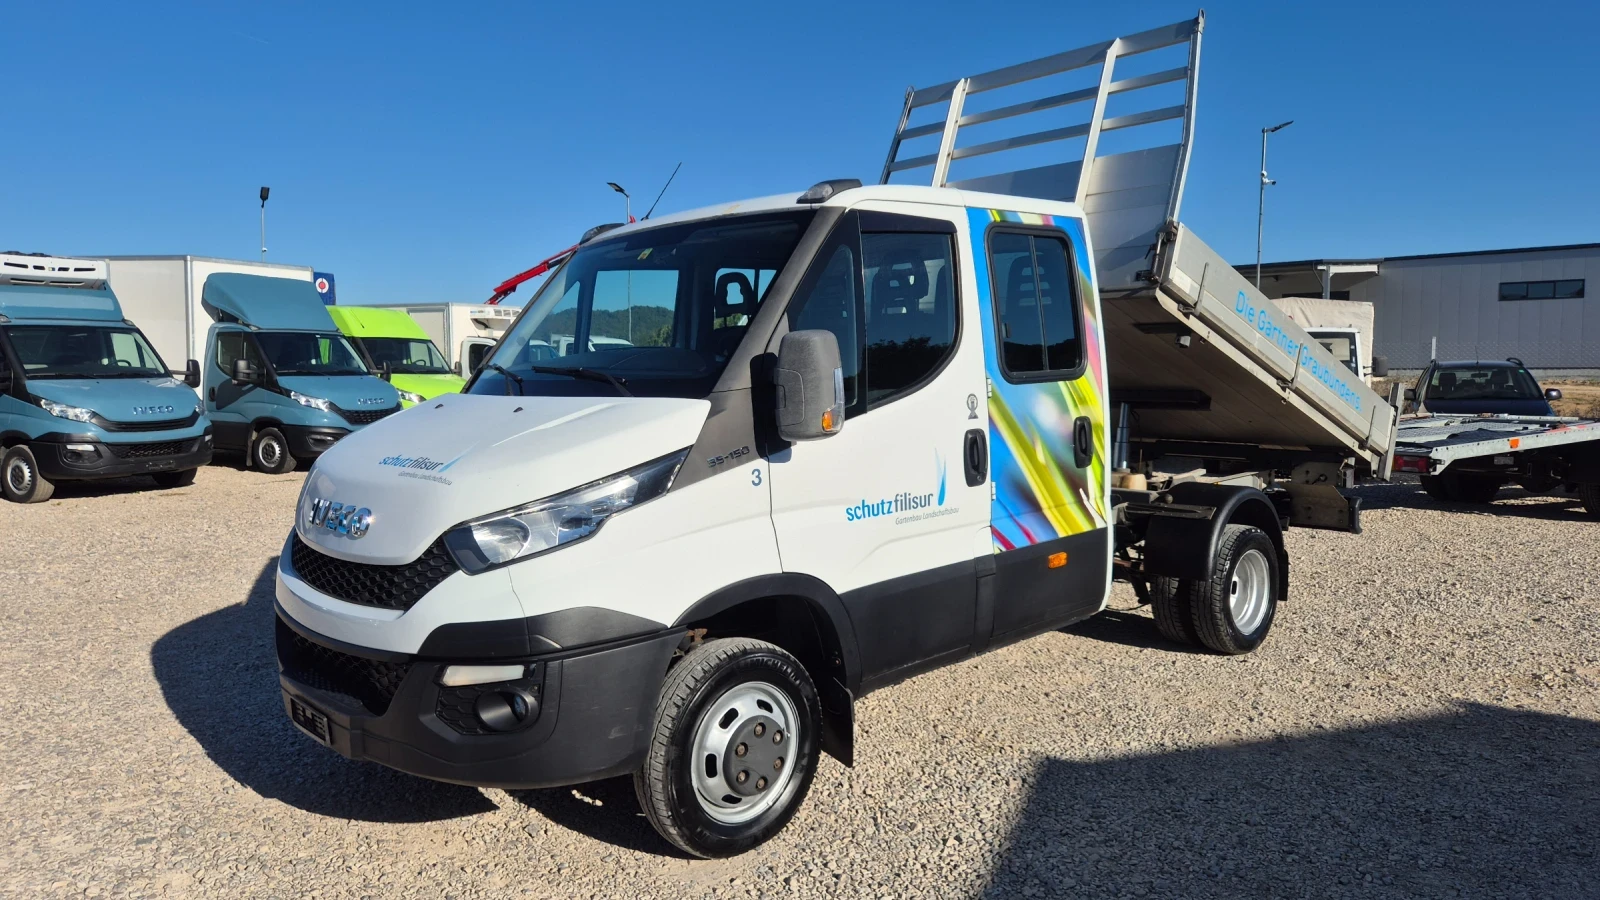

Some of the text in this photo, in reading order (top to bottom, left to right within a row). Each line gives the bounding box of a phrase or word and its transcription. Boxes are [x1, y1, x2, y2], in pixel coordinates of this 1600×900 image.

[1235, 290, 1255, 323] Die
[1257, 309, 1299, 358] Gärtner
[132, 405, 174, 415] IVECO
[357, 397, 385, 405] IVECO
[707, 446, 750, 468] 35-150
[751, 468, 762, 487] 3
[309, 498, 373, 538] IVECO
[895, 507, 960, 526] Gartenbau Landschaftsbau
